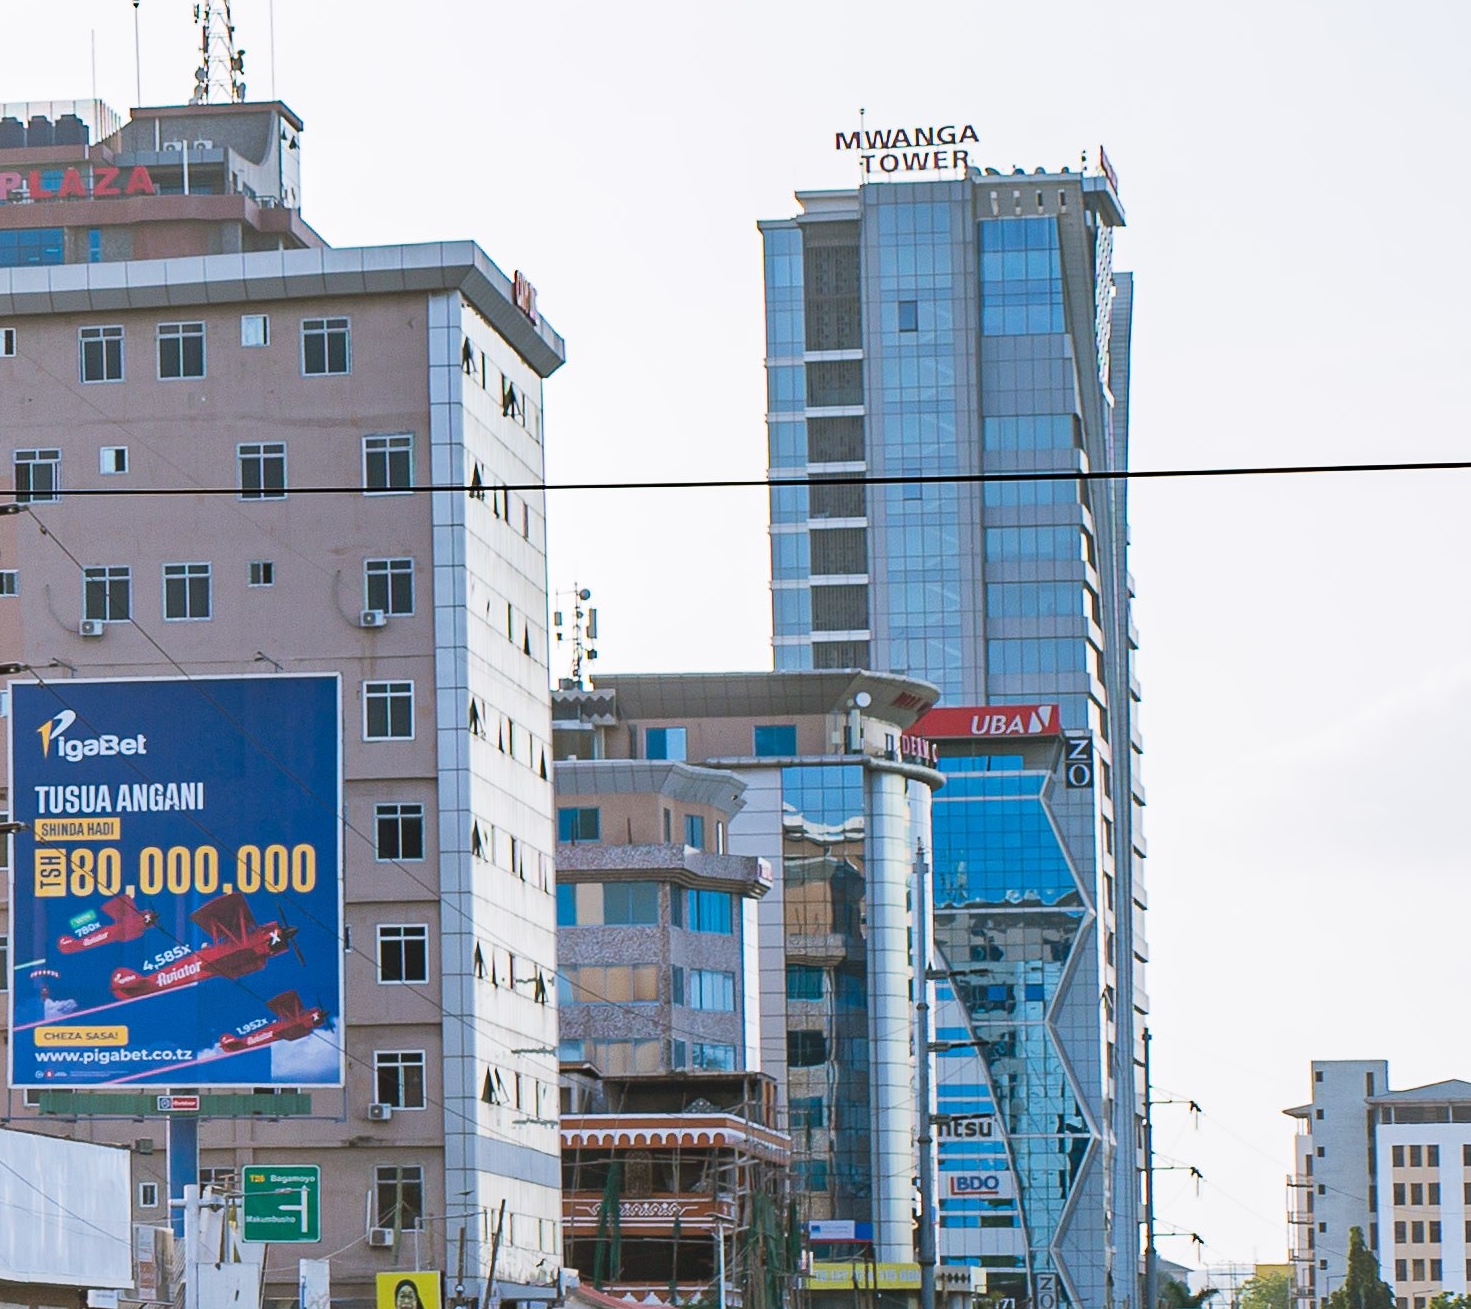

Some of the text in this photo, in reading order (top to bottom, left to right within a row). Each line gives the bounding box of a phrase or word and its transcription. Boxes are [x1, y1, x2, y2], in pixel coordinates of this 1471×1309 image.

[836, 125, 980, 150] MWANGA
[861, 150, 969, 173] TOWER
[36, 709, 147, 762] PigaBet
[970, 715, 1025, 734] UBA
[35, 782, 204, 814] TUSUA ANGANI
[41, 821, 114, 837] SHINDA HADI
[40, 855, 62, 890] TSH
[69, 843, 316, 899] 80,000,000
[156, 962, 202, 987] Aviator
[44, 1031, 118, 1041] CHEZA SASA!
[35, 1048, 193, 1064] www.pigabet.co.tz
[956, 1175, 999, 1190] BDO
